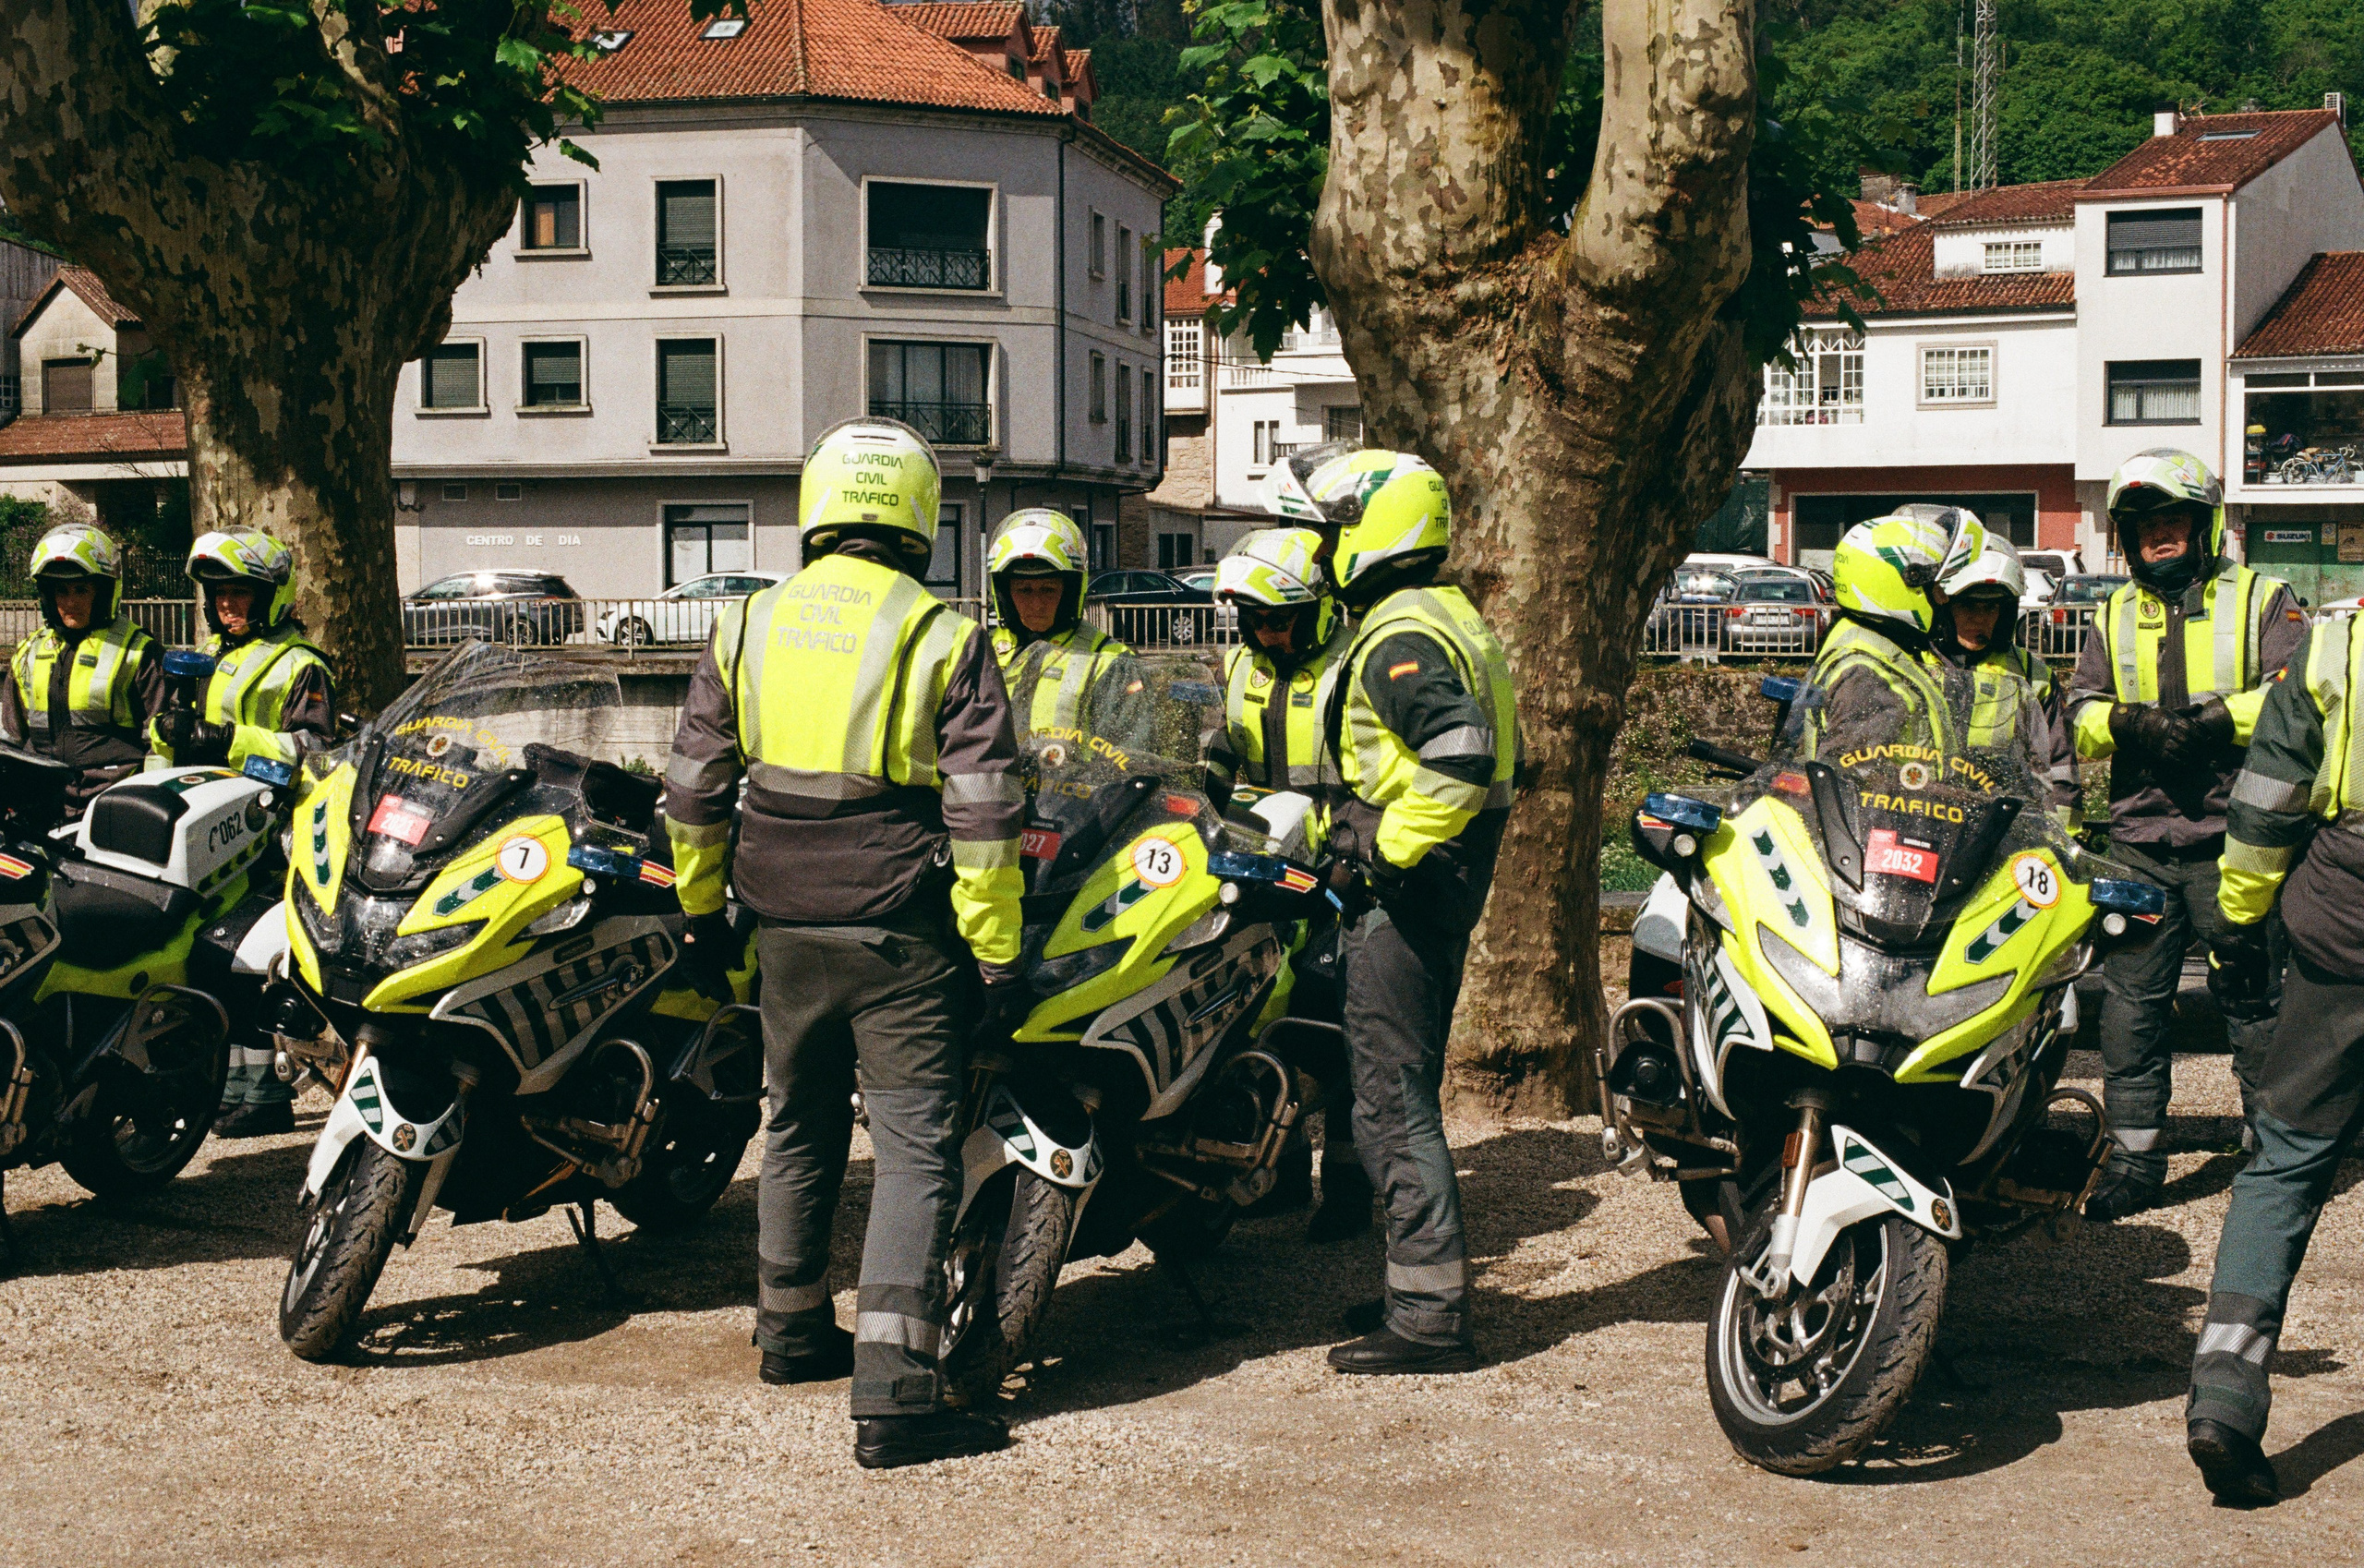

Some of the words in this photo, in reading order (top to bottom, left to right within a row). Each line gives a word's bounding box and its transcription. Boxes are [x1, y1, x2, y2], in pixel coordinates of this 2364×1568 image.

[842, 453, 903, 469] GUARDIA
[856, 472, 887, 486] CIVIL
[842, 488, 899, 507] TRÁFICO
[466, 535, 514, 546] CENTRO
[525, 535, 543, 546] DE
[558, 535, 582, 546] DIA
[2275, 532, 2311, 540] SUZUKI
[788, 583, 872, 606] GUARDIA
[800, 603, 843, 625] CIVIL
[777, 625, 858, 654] TRÁFICO
[394, 716, 475, 736] GUARDIA
[476, 730, 513, 765] CIVIL
[1017, 727, 1083, 744] ARDIA
[1090, 736, 1130, 771] CIVIL
[388, 756, 469, 789] TRAFICO
[1839, 744, 1944, 768] GUARDIA
[1949, 757, 1996, 796] CIVIL
[1020, 776, 1092, 800] AFICO
[1860, 791, 1964, 824] TRAFICO
[219, 811, 244, 845] 062
[1020, 833, 1045, 853] 027
[519, 847, 530, 869] 7
[1148, 848, 1171, 874] 13
[1881, 848, 1923, 874] 2032
[2027, 866, 2048, 895] 18
